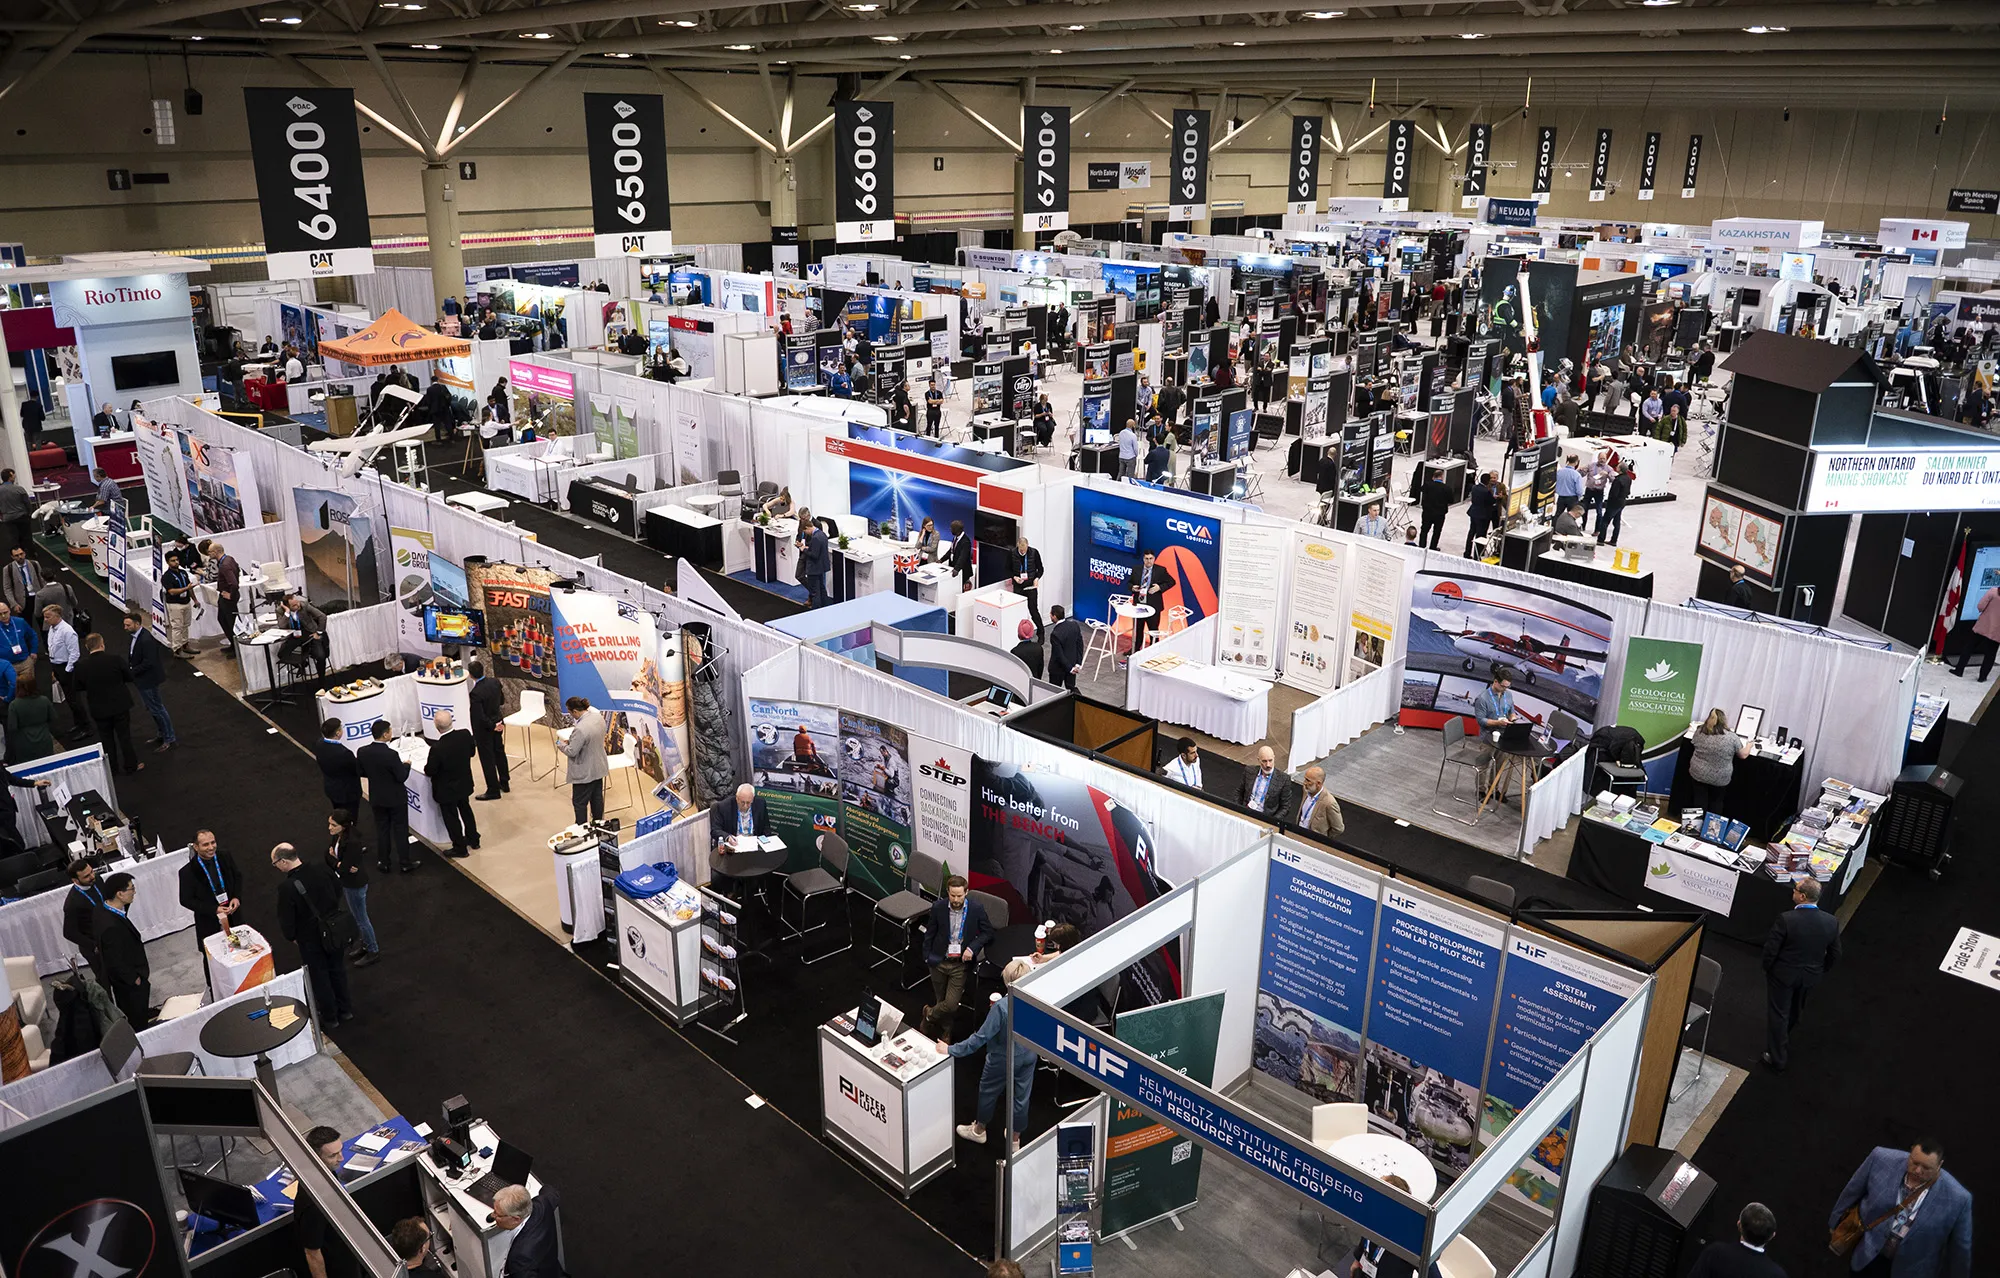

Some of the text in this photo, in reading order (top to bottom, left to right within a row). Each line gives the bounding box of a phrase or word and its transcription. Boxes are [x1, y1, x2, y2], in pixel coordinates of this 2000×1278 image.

[292, 103, 311, 111] PDAC
[853, 125, 878, 215] 6600
[1037, 128, 1056, 207] 6700
[1124, 165, 1147, 177] Mosaic
[1181, 129, 1199, 200] 6800
[1297, 133, 1313, 198] 6900
[1391, 136, 1407, 194] 7000
[1470, 139, 1484, 191] 7100
[1537, 140, 1551, 189] 7200
[1595, 141, 1607, 186] 7300
[1643, 144, 1656, 187] 7400
[1687, 146, 1698, 186] 7500
[285, 121, 338, 241] 6400
[611, 122, 647, 225] 6500
[1090, 169, 1103, 177] North
[1953, 190, 1998, 201] North Meeting
[1183, 206, 1192, 216] CAT
[1296, 203, 1307, 214] CAT
[1499, 206, 1531, 217] NEVADA
[860, 223, 873, 235] CAT
[1038, 215, 1053, 229] CAT
[1718, 228, 1790, 240] KAZAKHSTAN
[621, 235, 645, 253] CAT
[309, 252, 334, 268] CAT
[1240, 264, 1253, 273] GO
[312, 268, 334, 276] Financial
[684, 321, 695, 329] CN
[1828, 456, 1916, 472] NORTHERN ONTARIO
[1925, 455, 1988, 470] SALON MINIER
[1825, 471, 1909, 487] MINING SHOWCASE
[1922, 471, 1973, 485] DU NORD DE
[1185, 534, 1213, 545] LOGISTICS
[1090, 557, 1132, 576] RESPONSIVE
[1090, 565, 1125, 580] LOGISTICS
[1090, 572, 1121, 586] FOR YOU
[556, 622, 598, 637] TOTAL
[561, 636, 641, 651] CORE DRILLING
[565, 650, 638, 665] TECHNOLOGY
[1630, 687, 1686, 700] GEOLOGICAL
[751, 704, 799, 717] CanNorth
[1628, 700, 1685, 713] ASSOCIATION
[841, 716, 881, 734] CanNorth
[918, 764, 967, 786] STEP
[757, 790, 793, 801] Environment
[919, 787, 957, 812] CONNECTING
[920, 801, 968, 830] SASKATCHEWAN
[981, 785, 1080, 831] Hire better from
[871, 815, 880, 823] and
[981, 803, 1065, 845] THE BENCH
[872, 823, 900, 839] Engagement
[921, 814, 966, 843] BUSINESS WITH
[922, 828, 955, 852] THE WORLD.
[1683, 868, 1734, 889] GEOLOGICAL
[1292, 876, 1352, 907] EXPLORATION AND
[1682, 879, 1731, 901] ASSOCIATION
[1289, 884, 1352, 916] CHARACTERIZATION
[1280, 905, 1309, 921] exploration
[1287, 918, 1344, 950] digital generation
[1343, 923, 1364, 936] mineral
[1395, 918, 1484, 958] PROCESS DEVELOPMENT
[1277, 935, 1299, 949] Machine
[1391, 925, 1486, 969] FROM LAB TO PILOT SCALE
[1288, 948, 1316, 966] processing
[1336, 947, 1359, 962] samples
[1947, 931, 1982, 975] Trade Show
[1274, 961, 1319, 987] mineral chemistry
[1390, 960, 1471, 999] Flotation from fundamentals
[1403, 974, 1419, 985] scale
[1417, 957, 1473, 985] particle processing
[1282, 983, 1307, 999] materials
[1555, 980, 1588, 999] SYSTEM
[1327, 995, 1350, 1011] complex
[1388, 981, 1459, 1017] Biotechnologies metal
[1542, 986, 1597, 1012] ASSESSMENT
[1433, 1009, 1464, 1027] separation
[1515, 1012, 1554, 1032] optimization
[1422, 1021, 1452, 1038] extraction
[1554, 1020, 1581, 1035] process
[1513, 1026, 1557, 1050] Particle-based
[1056, 1024, 1129, 1079] HiF
[1507, 1063, 1544, 1084] Technology
[860, 1090, 886, 1114] PETER
[859, 1099, 887, 1124] LUCAS
[1138, 1073, 1215, 1122] HELMHOLTZ
[1218, 1115, 1289, 1164] INSTITUTE
[1293, 1157, 1364, 1204] FREIBERG
[1138, 1086, 1163, 1107] FOR
[1166, 1101, 1234, 1148] RESOURCE
[1236, 1140, 1329, 1199] TECHNOLOGY
